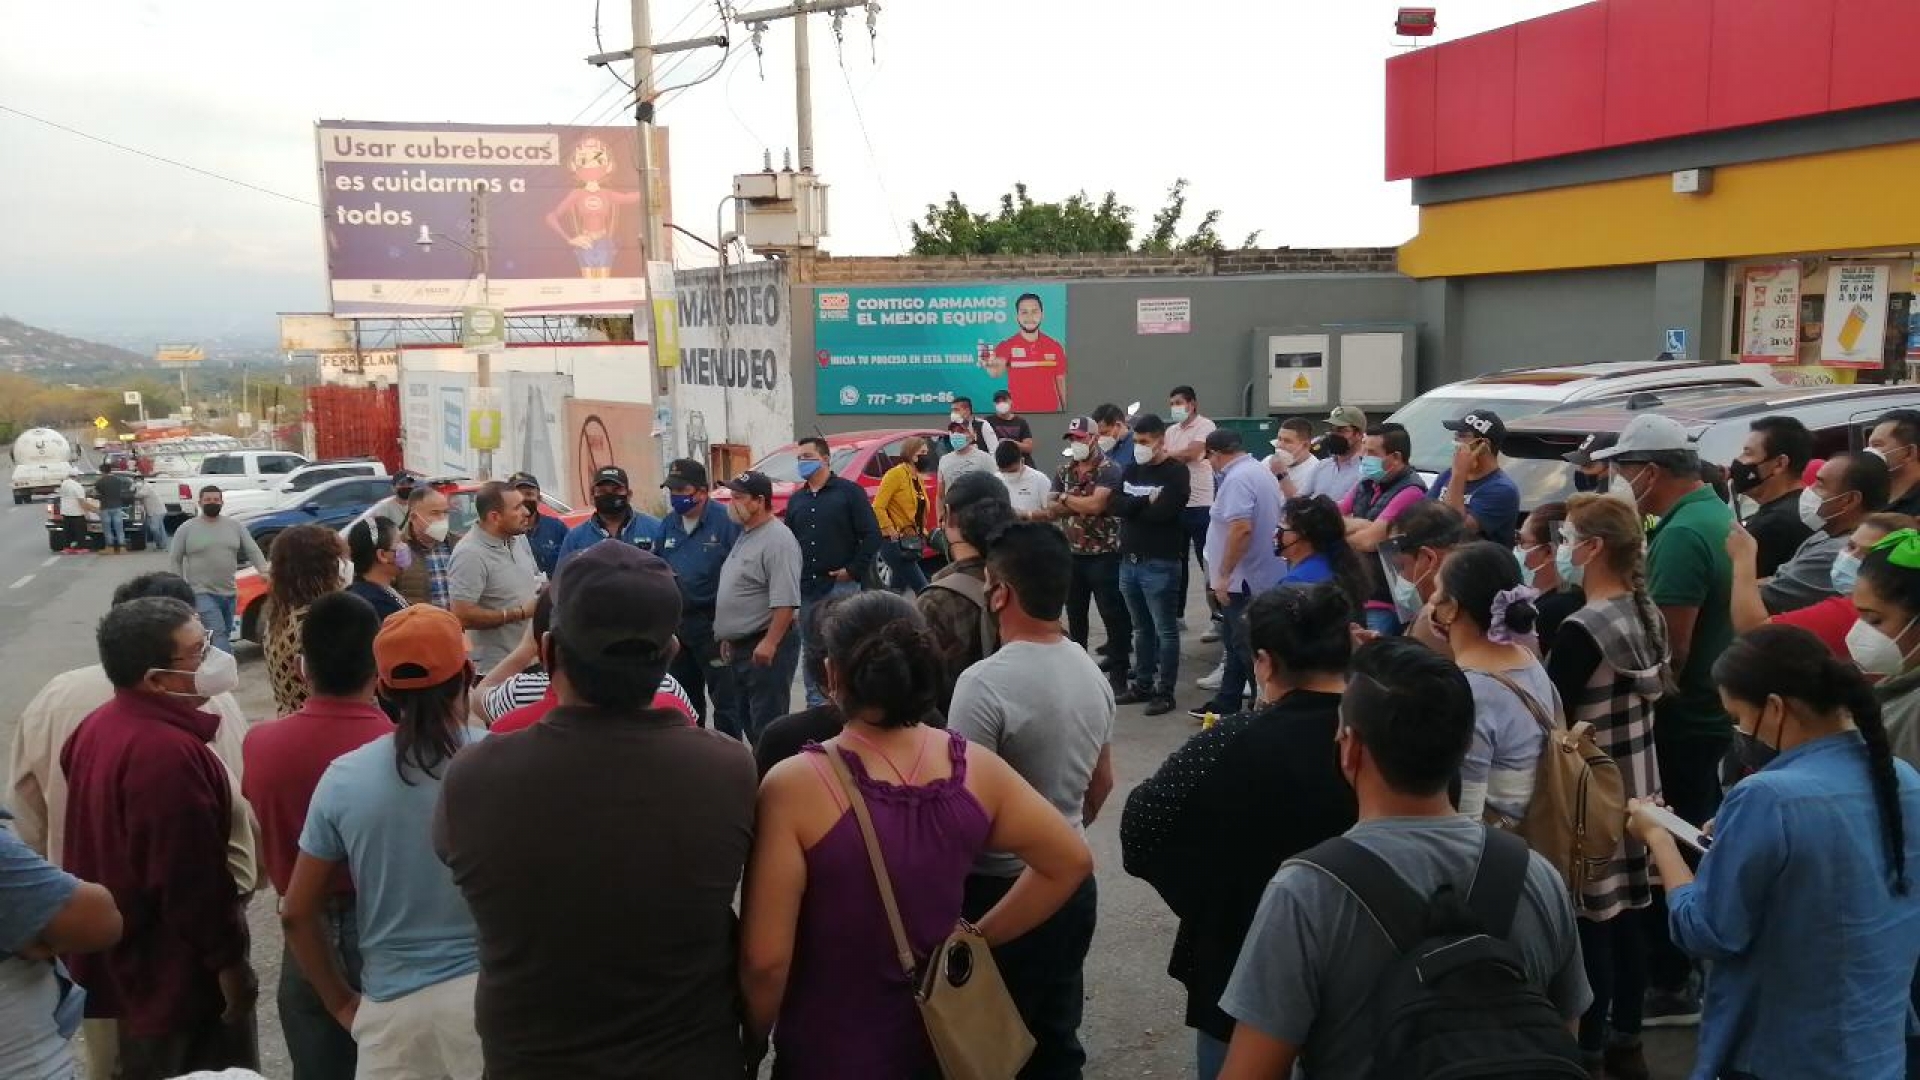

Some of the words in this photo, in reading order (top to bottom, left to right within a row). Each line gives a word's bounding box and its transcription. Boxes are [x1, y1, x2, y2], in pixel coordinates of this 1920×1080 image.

[334, 135, 396, 157] Usar
[404, 137, 553, 160] cubrebocas
[335, 174, 365, 191] es
[372, 169, 502, 193] cuidarnos
[509, 177, 526, 193] a
[336, 202, 413, 226] todos
[678, 284, 780, 328] MAYOREO
[857, 298, 925, 310] CONTIGO
[928, 296, 1008, 309] ARMAMOS
[857, 312, 877, 325] EL
[881, 311, 938, 325] MEJOR
[943, 310, 1008, 326] EQUIPO
[680, 347, 777, 390] MENUDEO
[858, 355, 870, 364] TU
[871, 354, 906, 364] PROCESO
[909, 354, 921, 363] EN
[923, 354, 943, 363] ESTA
[945, 353, 974, 363] TIENDA
